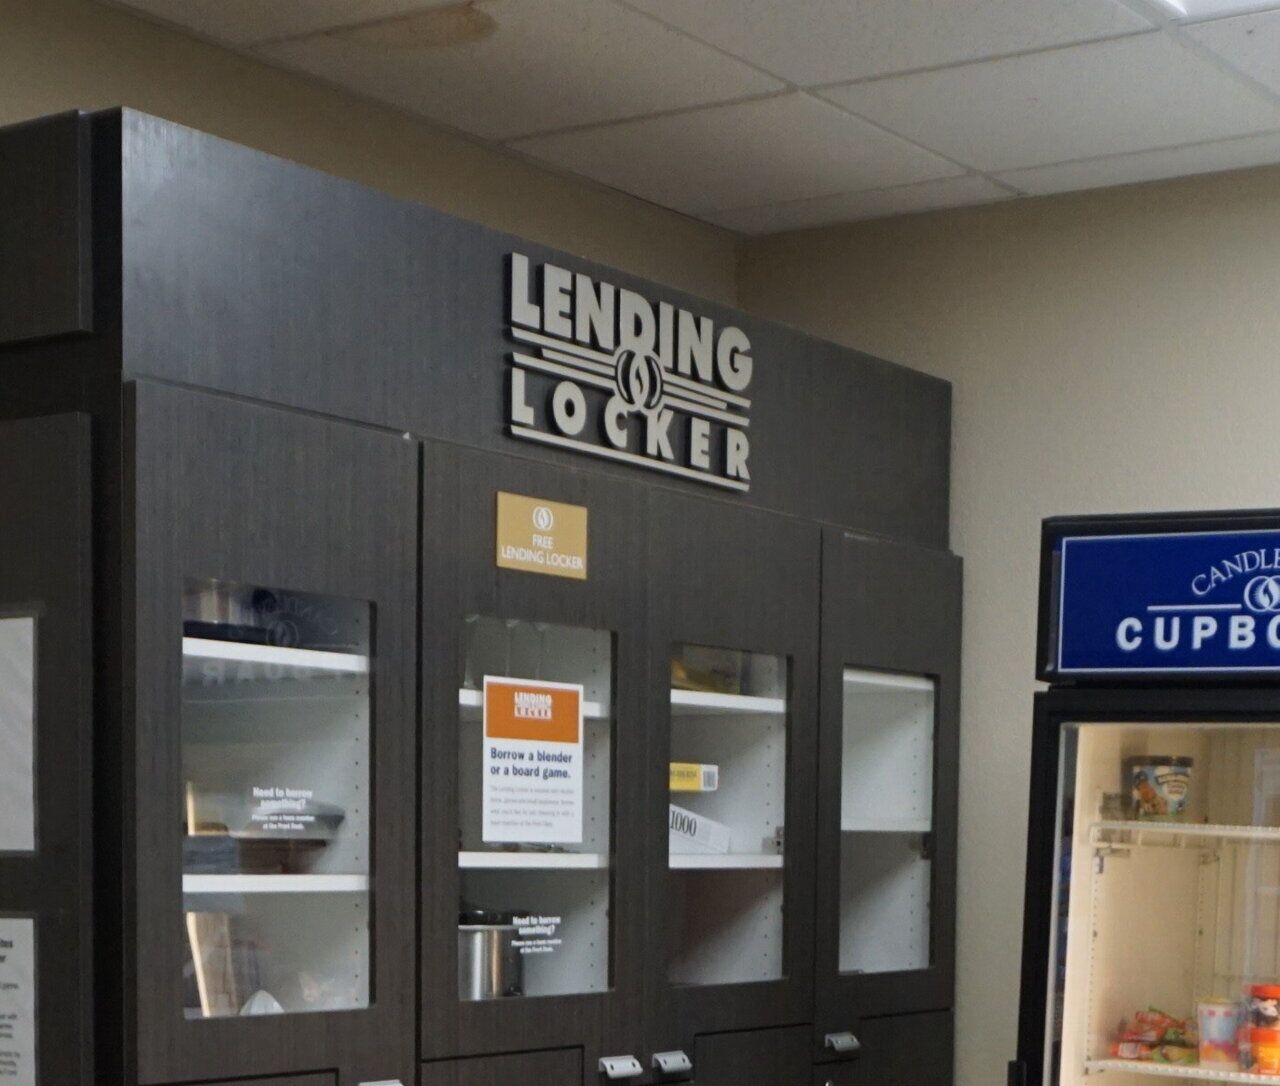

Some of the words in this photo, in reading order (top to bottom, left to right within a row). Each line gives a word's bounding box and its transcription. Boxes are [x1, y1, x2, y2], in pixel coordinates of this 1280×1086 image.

[511, 252, 753, 392] LENDING
[511, 367, 751, 481] LOCKER
[532, 534, 554, 550] FREE
[501, 546, 545, 565] LENDING
[545, 550, 584, 570] LOCKER
[490, 747, 525, 760] Borrow
[528, 752, 534, 760] a
[537, 750, 573, 763] blender
[490, 766, 501, 775] or
[503, 767, 509, 776] a
[512, 764, 540, 777] board
[670, 810, 697, 837] 1000
